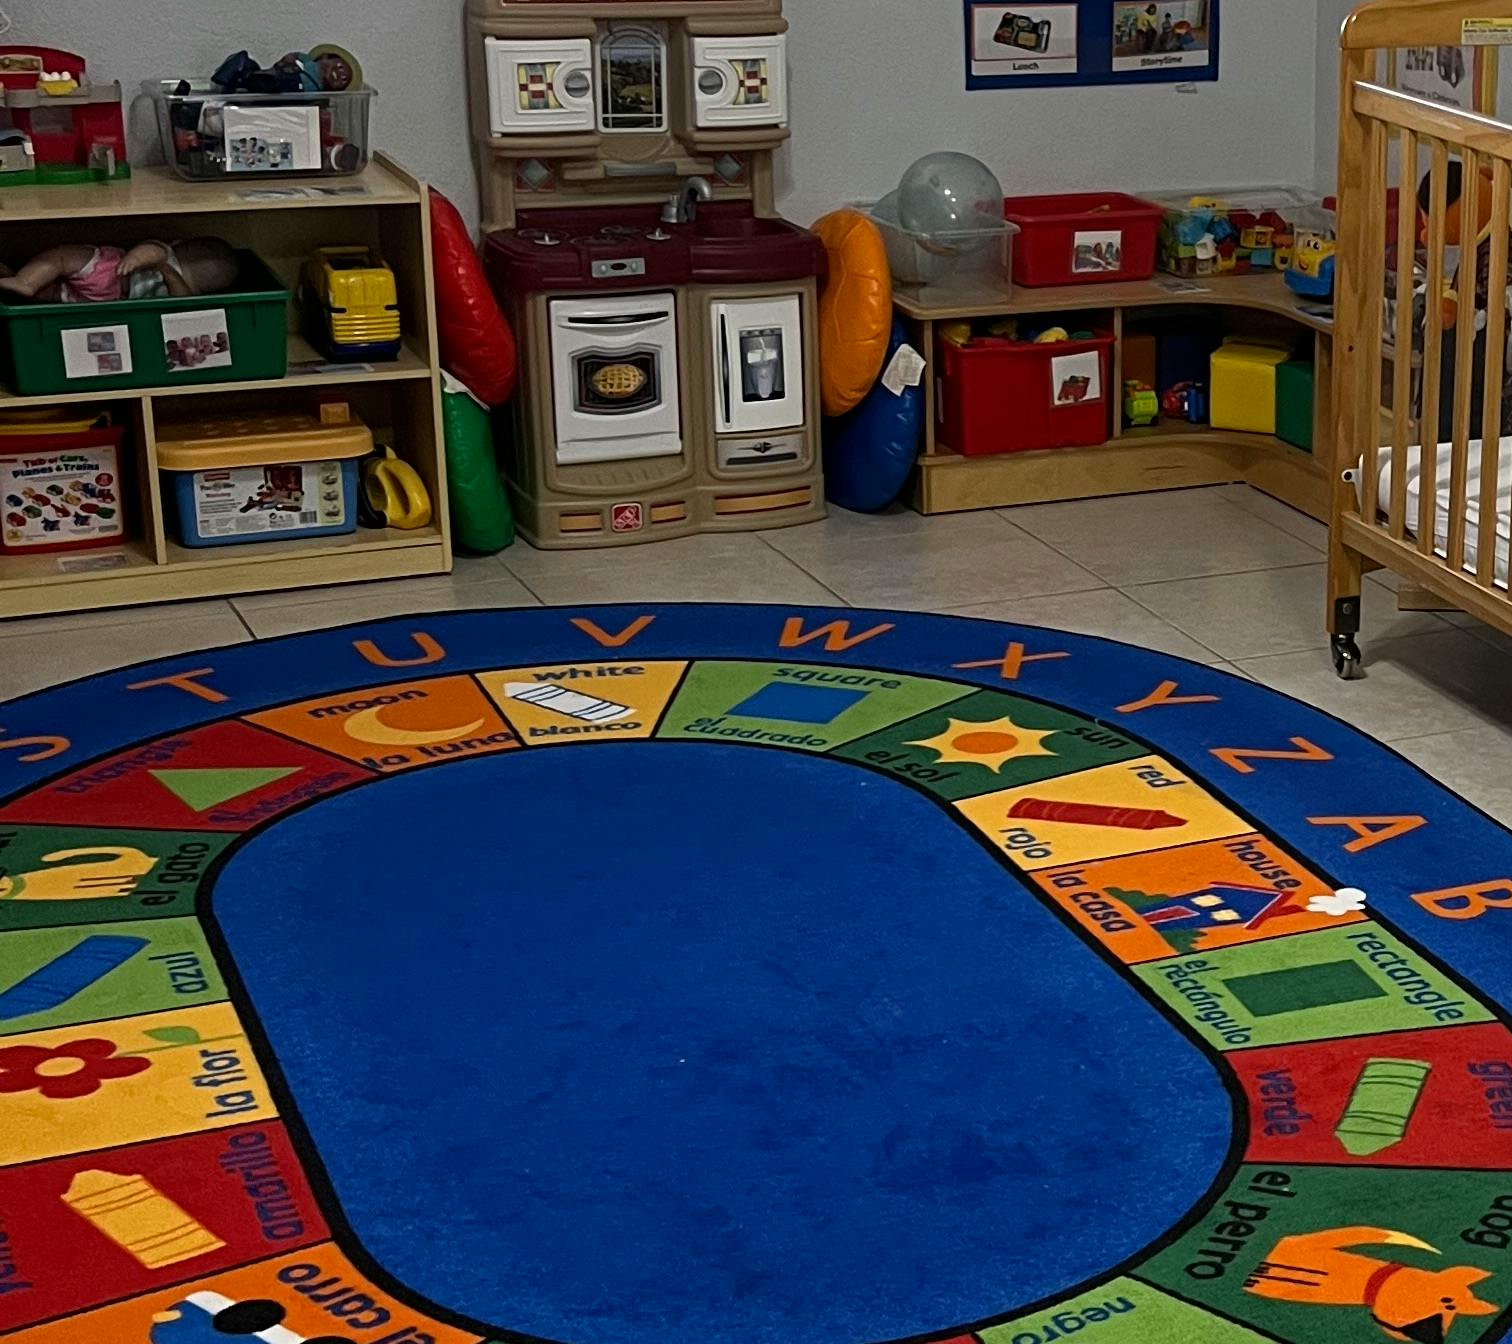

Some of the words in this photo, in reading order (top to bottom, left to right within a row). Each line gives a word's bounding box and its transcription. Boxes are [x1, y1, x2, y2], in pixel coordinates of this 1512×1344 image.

[1013, 61, 1039, 71] Lunch
[1141, 55, 1182, 67] Storytime
[12, 466, 53, 478] Planes
[23, 459, 46, 468] Tub
[533, 663, 646, 683] white
[772, 665, 903, 691] square
[307, 688, 429, 720] moon
[126, 667, 230, 704] T
[352, 632, 446, 668] U
[570, 615, 656, 648] V
[779, 616, 896, 651] W
[951, 641, 1072, 679] X
[1113, 680, 1221, 713] Y
[1208, 736, 1335, 774] Z
[1305, 815, 1428, 853] A
[529, 719, 642, 738] blanco
[683, 721, 828, 747] cuadrado
[1063, 723, 1132, 751] sun
[363, 750, 409, 770] la
[418, 730, 518, 759] luna
[864, 748, 903, 769] el
[898, 758, 960, 784] sol
[1128, 762, 1188, 790] red
[998, 826, 1054, 860] rojo
[157, 842, 211, 885] gato
[1224, 838, 1304, 890] house
[140, 889, 179, 908] el
[1047, 868, 1079, 890] la
[1070, 890, 1138, 934] casa
[148, 951, 211, 994] azul
[1184, 958, 1219, 972] el
[1346, 931, 1465, 1022] rectangle
[1157, 963, 1252, 1046] rectángulo
[193, 1048, 250, 1088] flor
[205, 1088, 260, 1119] la
[1255, 1067, 1313, 1137] verde
[218, 1130, 305, 1242] amarillo
[1247, 1170, 1298, 1200] el
[1184, 1199, 1272, 1281] perro
[276, 1263, 391, 1330] carro
